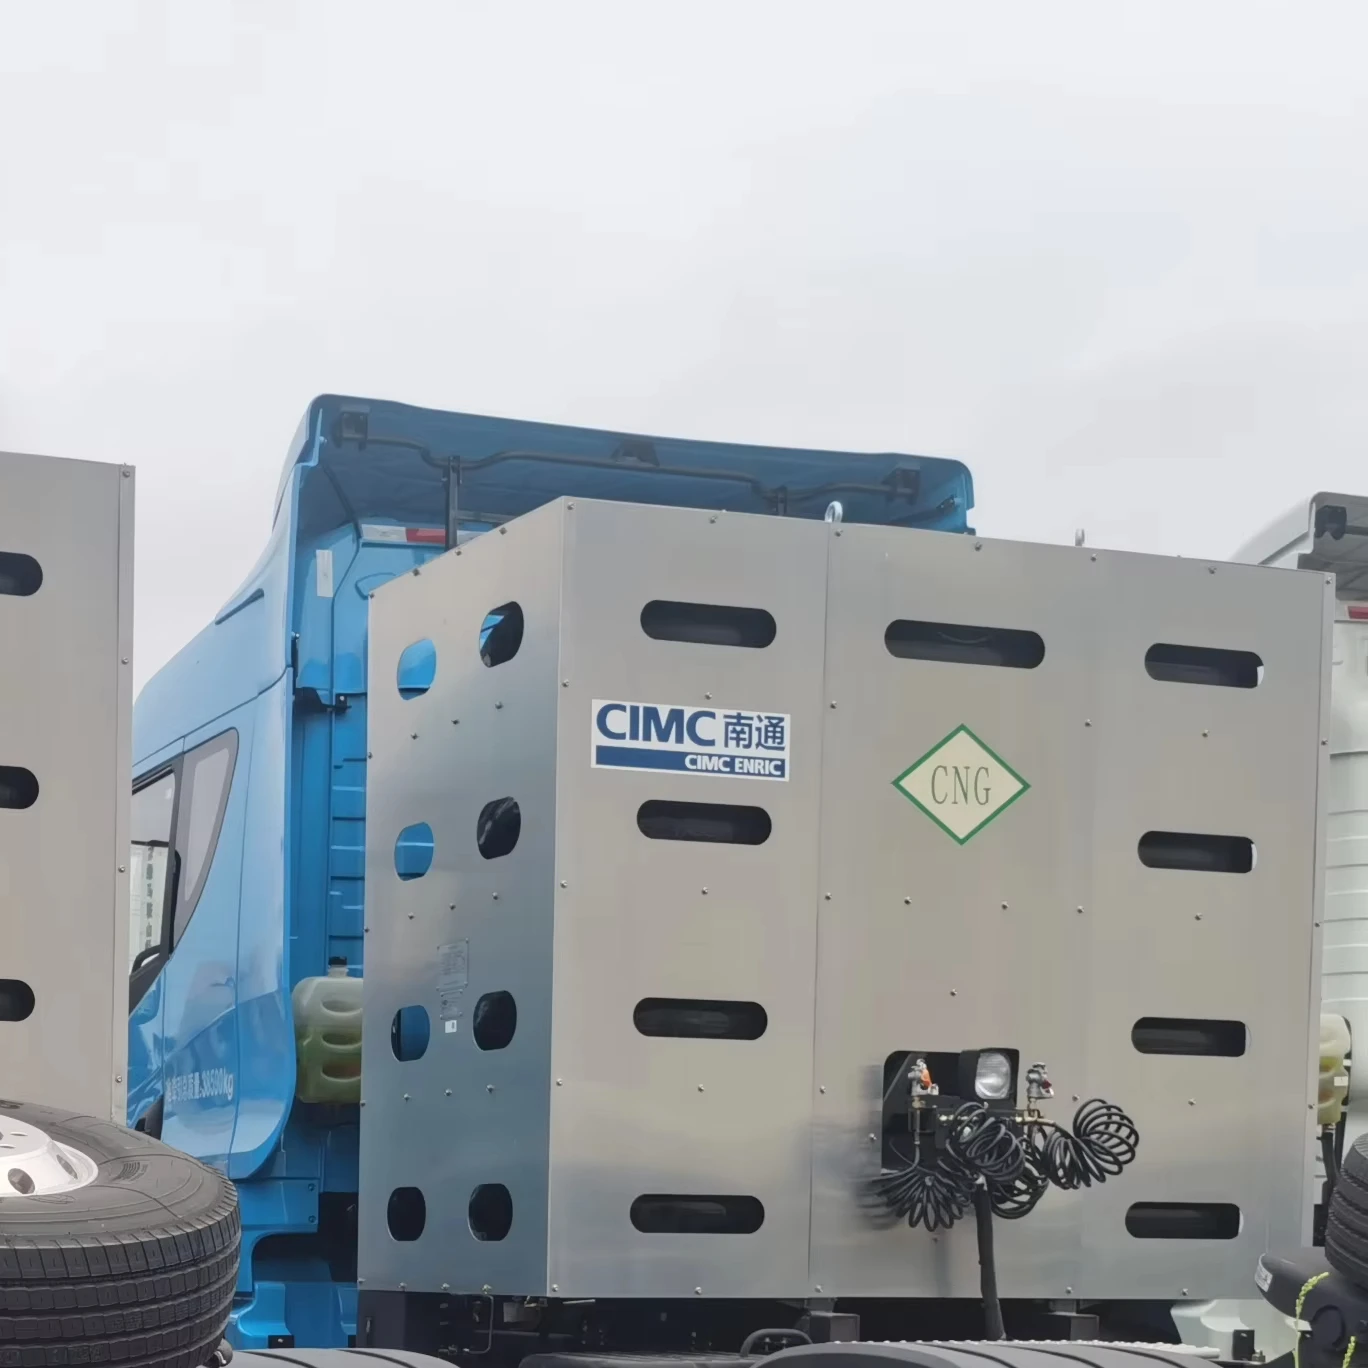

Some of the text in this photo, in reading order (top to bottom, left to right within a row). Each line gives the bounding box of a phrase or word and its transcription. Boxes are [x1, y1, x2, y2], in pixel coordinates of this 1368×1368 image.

[596, 703, 785, 751] CIMC 南通
[684, 754, 782, 776] CIMC ENRIC
[931, 765, 992, 806] CNG
